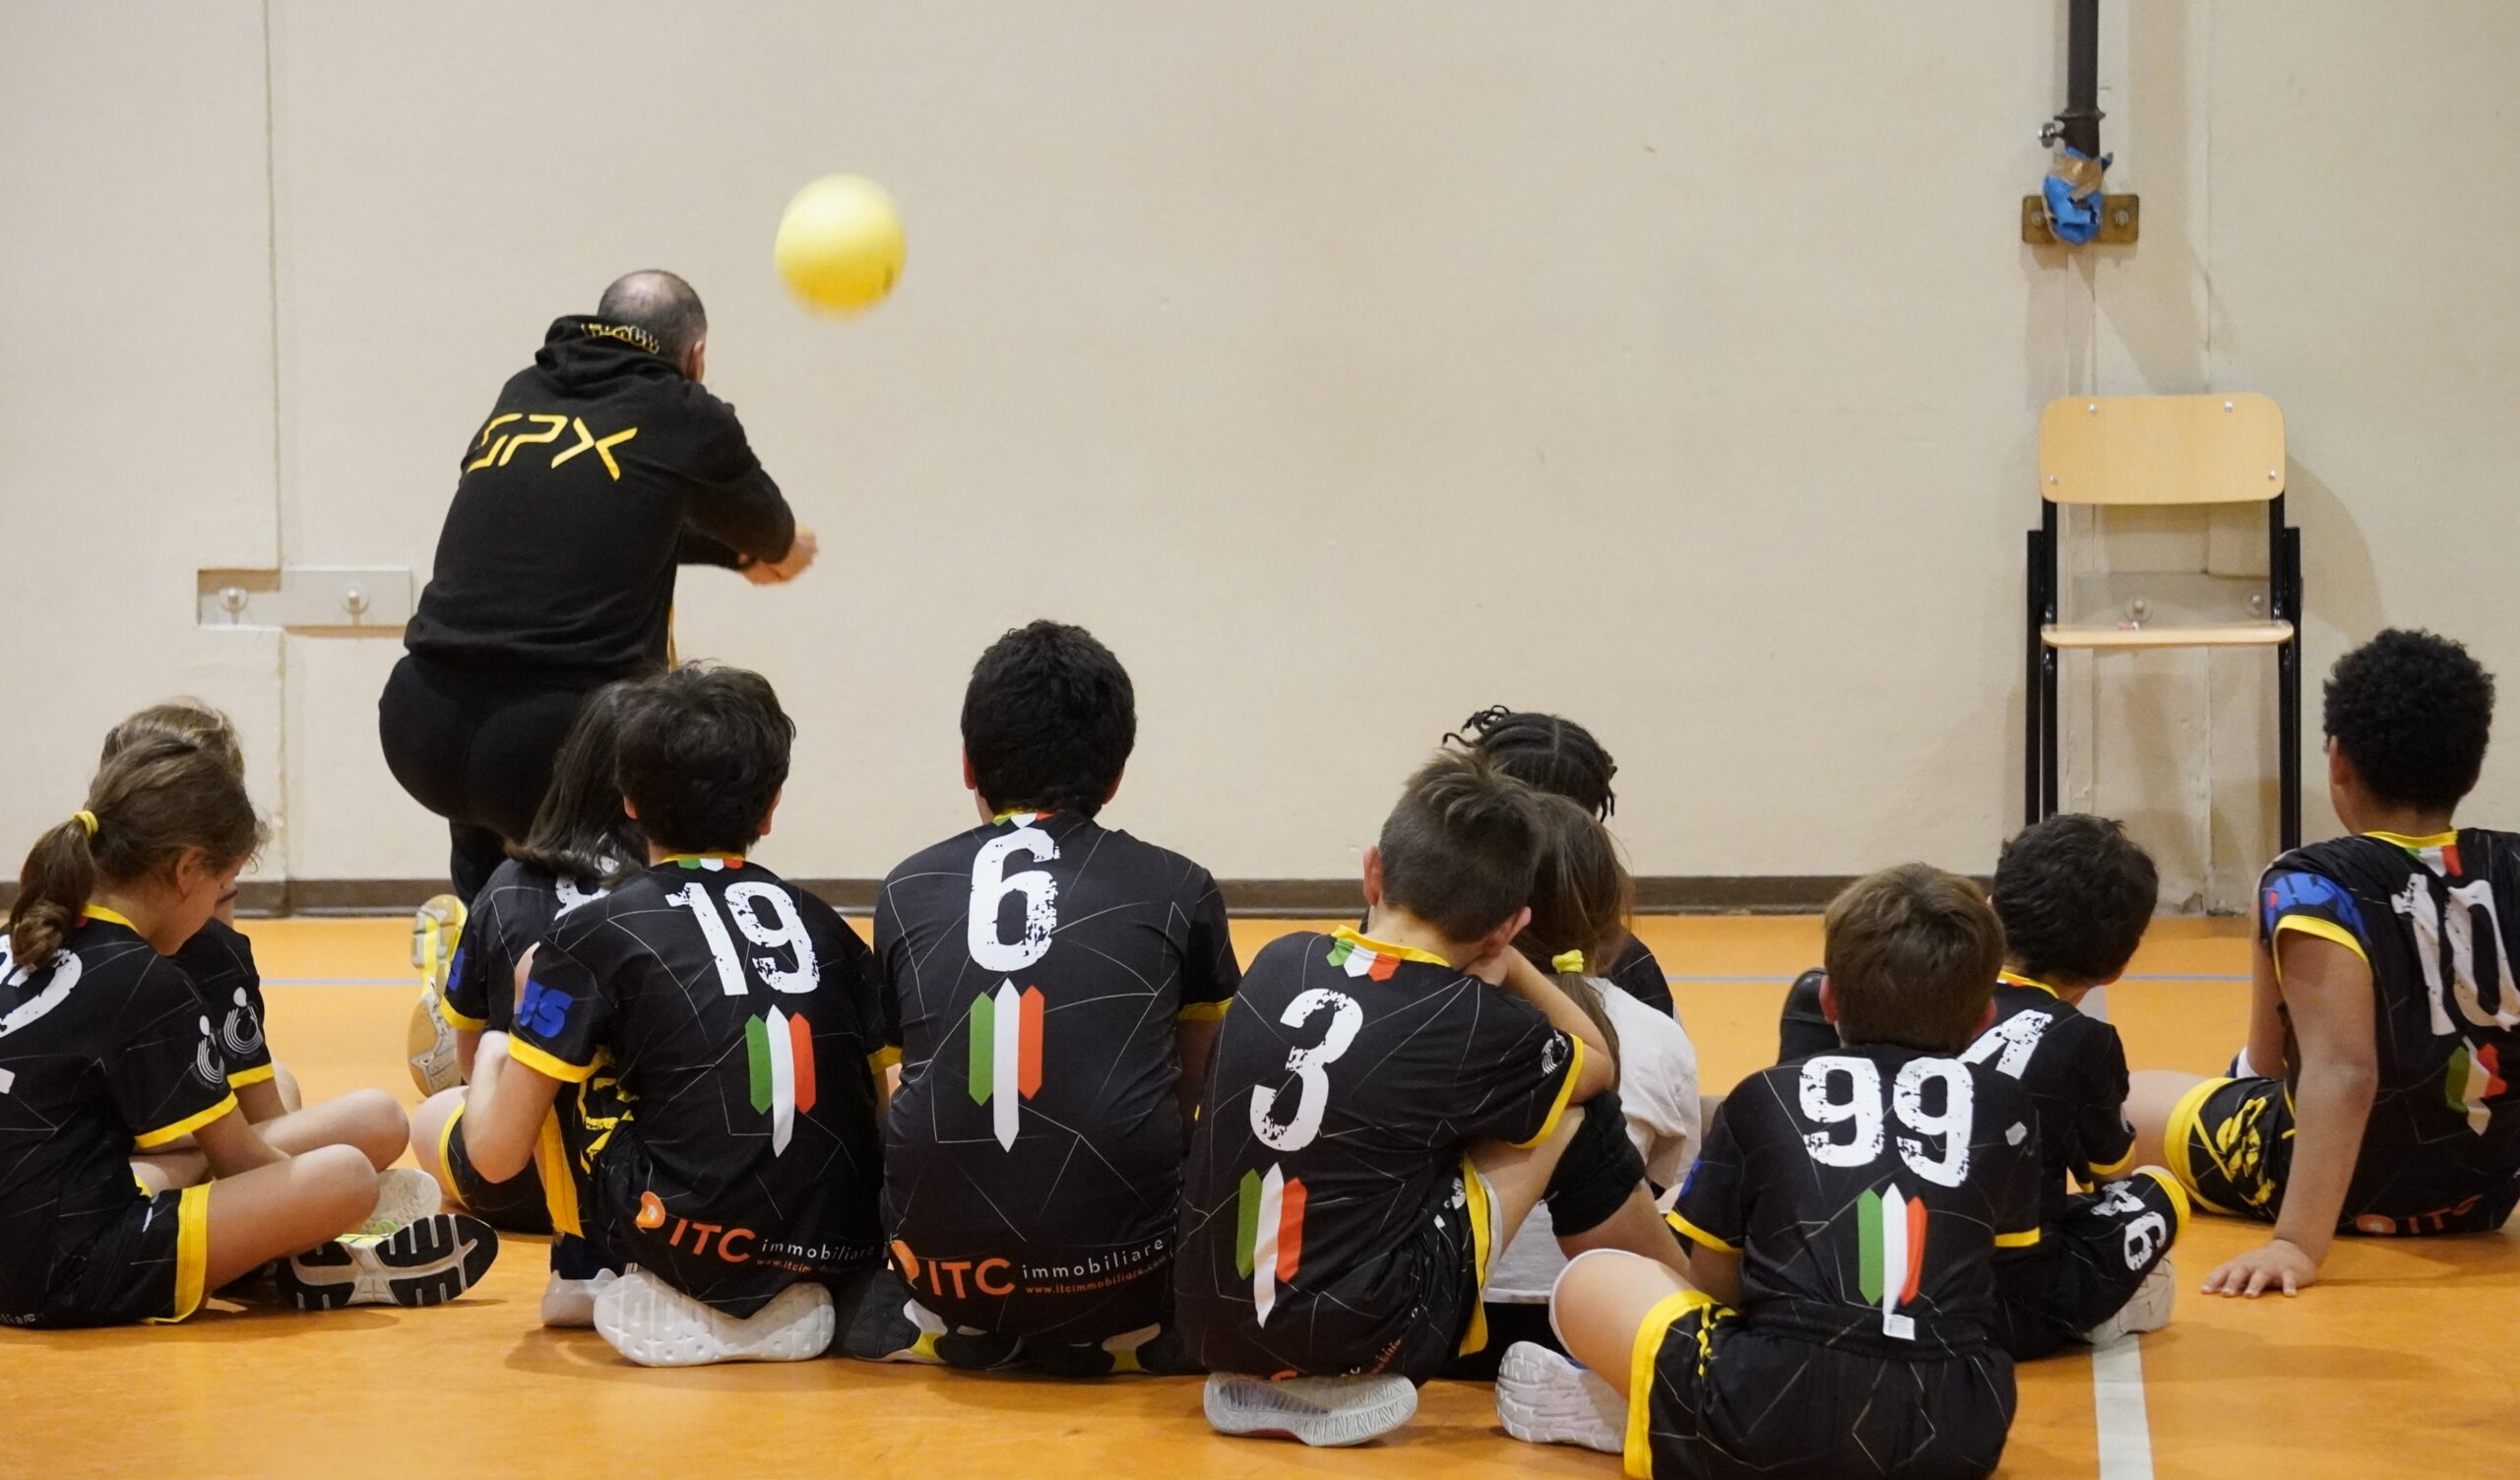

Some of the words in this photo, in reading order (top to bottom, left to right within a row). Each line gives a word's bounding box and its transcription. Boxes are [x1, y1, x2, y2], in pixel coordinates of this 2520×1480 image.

[466, 413, 638, 482] SPX
[664, 881, 821, 996] 19
[968, 827, 1060, 972] 6
[2391, 872, 2520, 1036] 10
[1249, 988, 1364, 1152] 3
[1798, 1056, 1975, 1188] 99
[668, 1218, 757, 1263] ITC
[927, 1257, 1017, 1300] ITC
[1021, 1237, 1165, 1279] immobiliare
